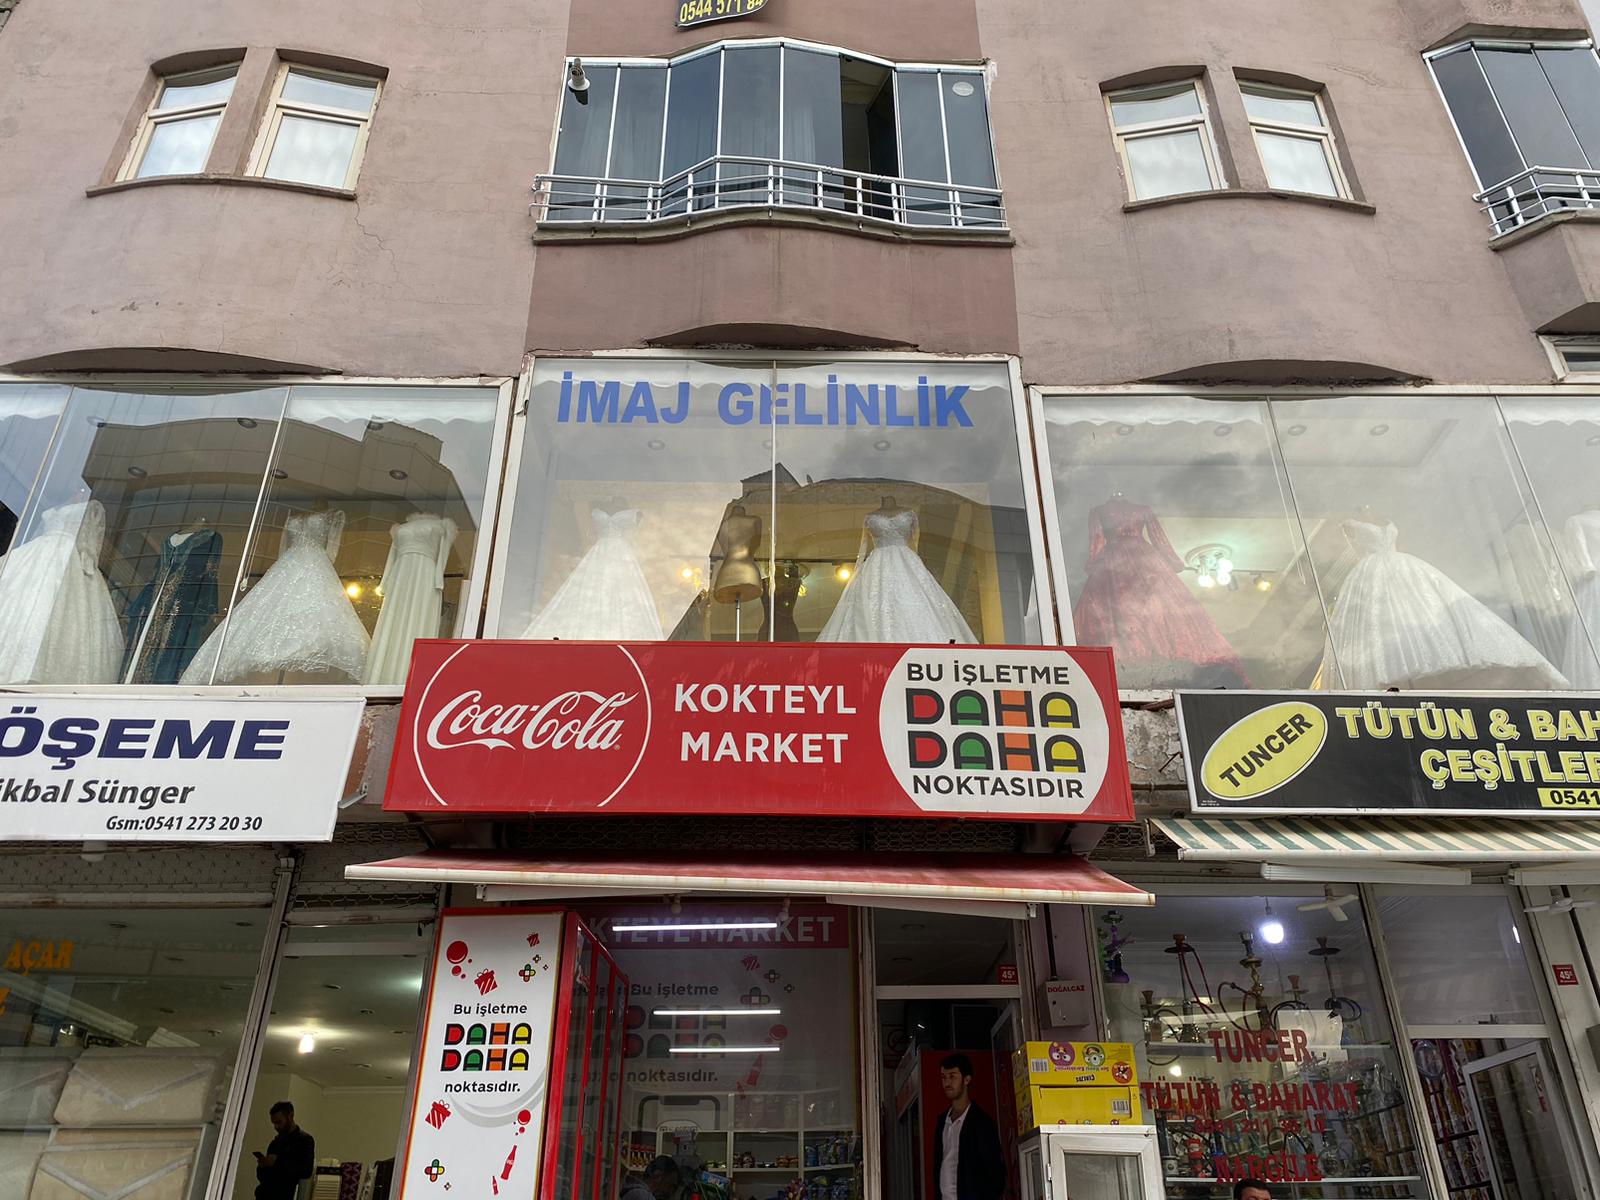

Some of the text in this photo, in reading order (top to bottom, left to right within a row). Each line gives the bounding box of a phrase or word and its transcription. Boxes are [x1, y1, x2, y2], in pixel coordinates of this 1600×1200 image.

[680, 0, 712, 22] 0544
[557, 371, 974, 428] İMAJ GELİNLİK
[907, 660, 1070, 686] BU İŞLETME
[674, 683, 857, 714] KOKTEYL
[905, 688, 1080, 728] DAHA
[427, 690, 639, 750] Coca-Cola
[1335, 701, 1600, 741] TÜTÜN & BAH
[0, 706, 290, 770] ÖŞEME
[681, 732, 848, 763] MARKET
[908, 730, 1086, 773] DAHA
[1219, 713, 1313, 787] TUNCER
[78, 779, 195, 809] Sünger
[913, 775, 1084, 798] NOKTASIDIR
[1549, 790, 1600, 805] 0541
[106, 815, 262, 831] Gsm:0541 273 20 30
[701, 916, 834, 942] MARKET
[631, 984, 651, 995] Bu
[657, 983, 719, 998] işletme
[453, 1003, 528, 1017] Bu işletme
[444, 1022, 532, 1045] DAHA
[1208, 1030, 1313, 1064] TUNCER
[440, 1048, 530, 1071] DAHA
[444, 1081, 521, 1093] noktasıdır.
[627, 1069, 718, 1082] noktasıdır.
[1140, 1076, 1360, 1112] TÜTÜN & BAHARAT
[1215, 1149, 1324, 1184] NARGİLE
